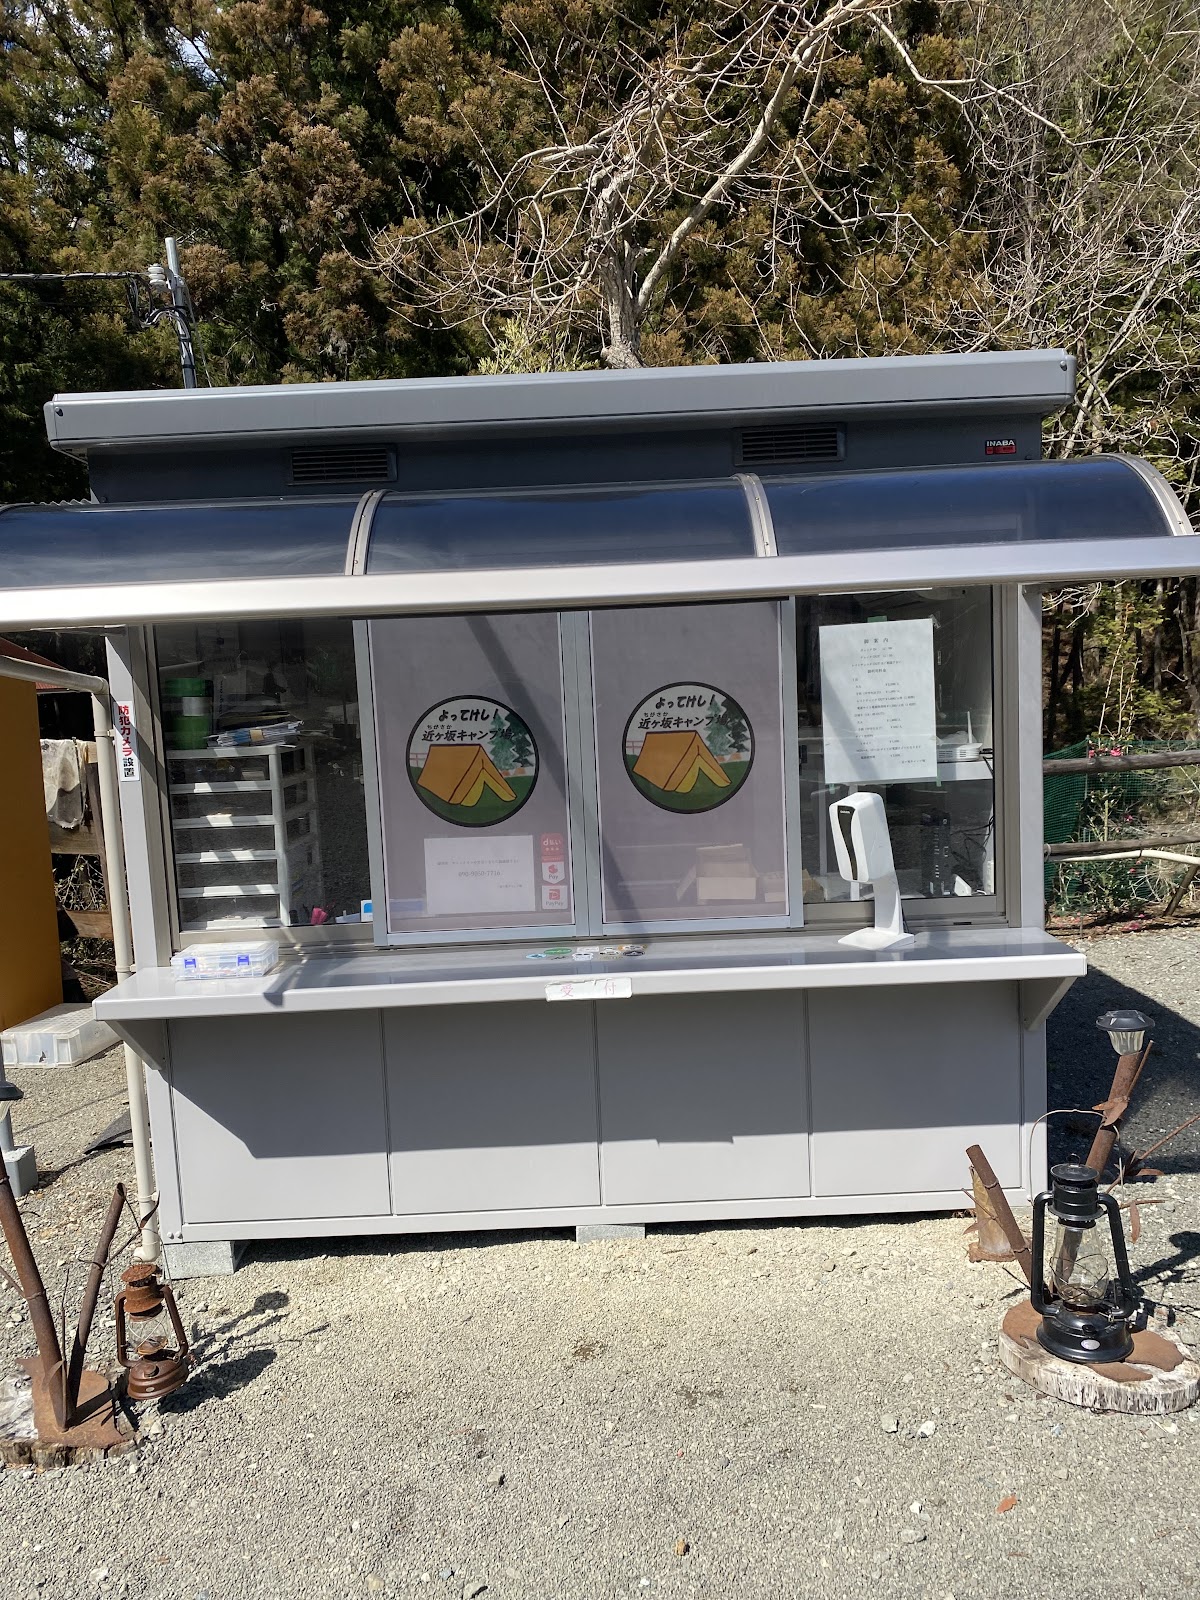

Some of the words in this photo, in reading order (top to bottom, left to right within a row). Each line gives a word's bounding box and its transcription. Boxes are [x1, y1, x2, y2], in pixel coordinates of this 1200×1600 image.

[986, 439, 1015, 447] INABA
[117, 704, 135, 778] 防犯カメラ設置
[560, 981, 617, 998] 受付
